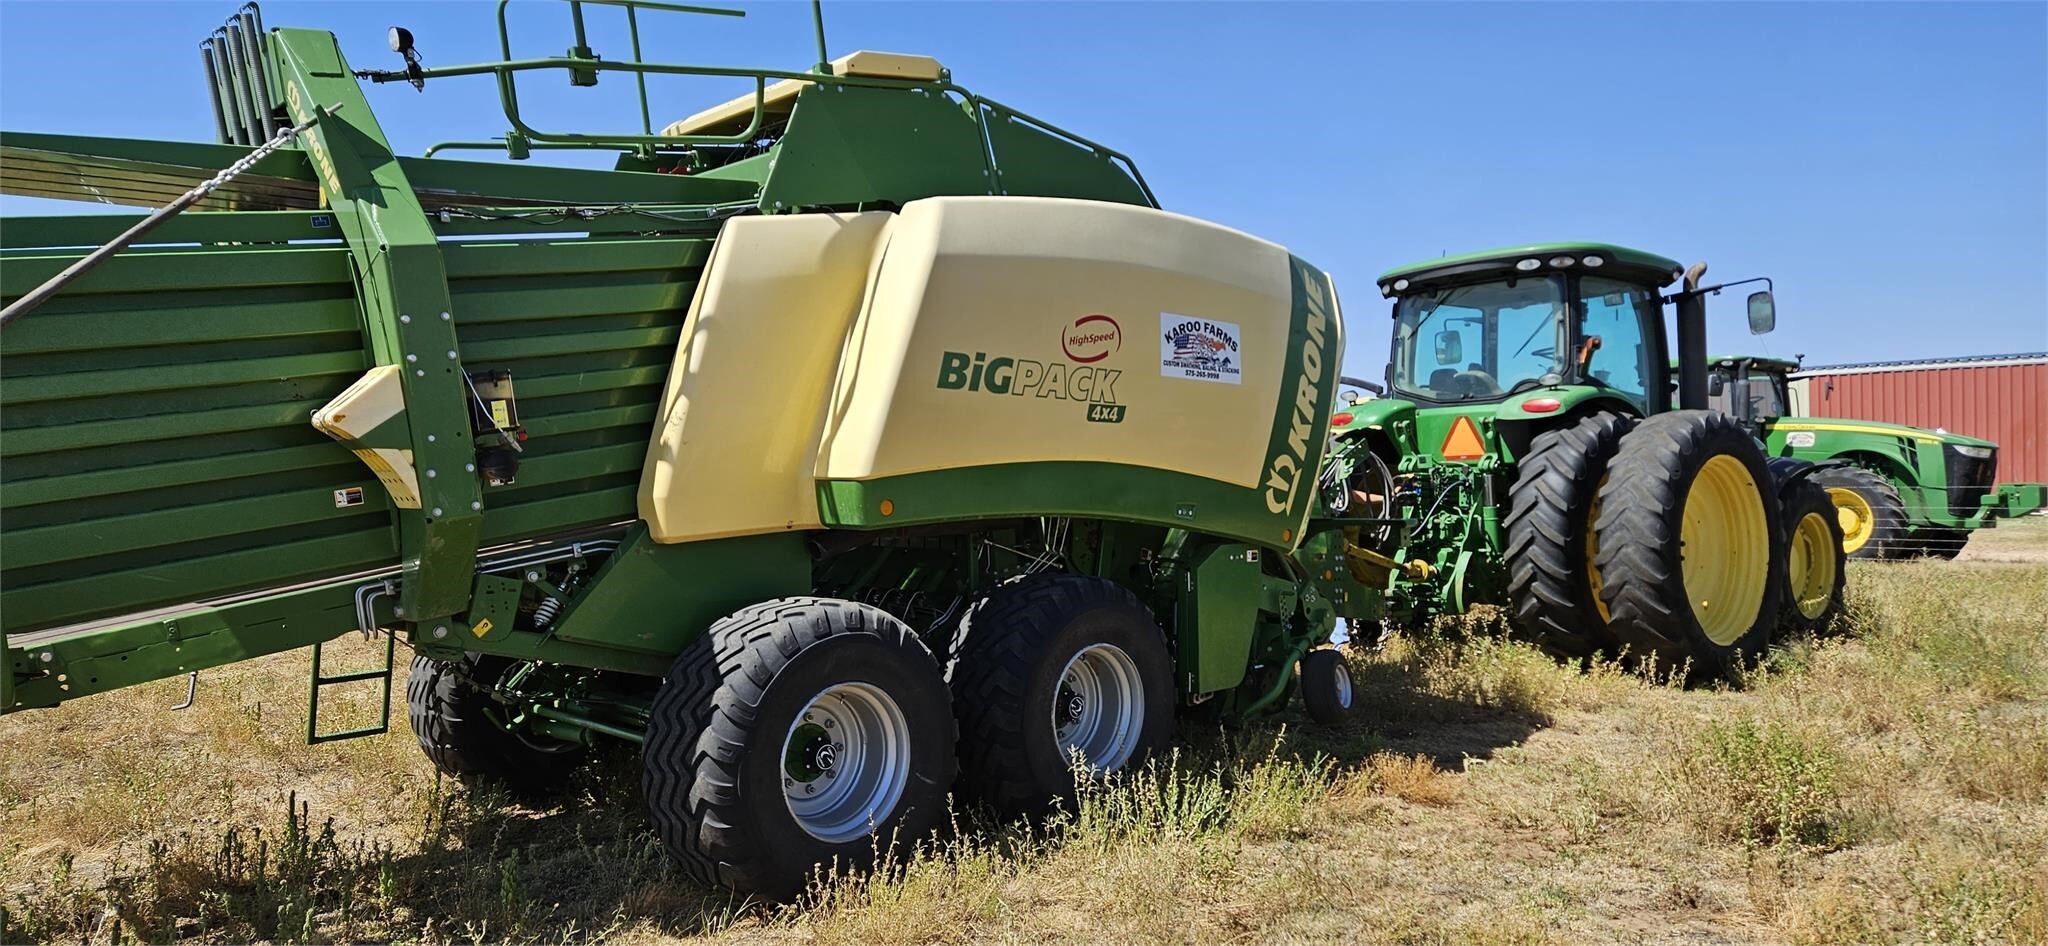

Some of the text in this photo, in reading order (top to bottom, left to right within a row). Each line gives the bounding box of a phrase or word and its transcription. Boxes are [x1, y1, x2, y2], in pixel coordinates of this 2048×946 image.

[1069, 331, 1115, 347] HighSpeed
[1164, 321, 1238, 352] KAROO FARMS
[1288, 268, 1326, 461] KRONE
